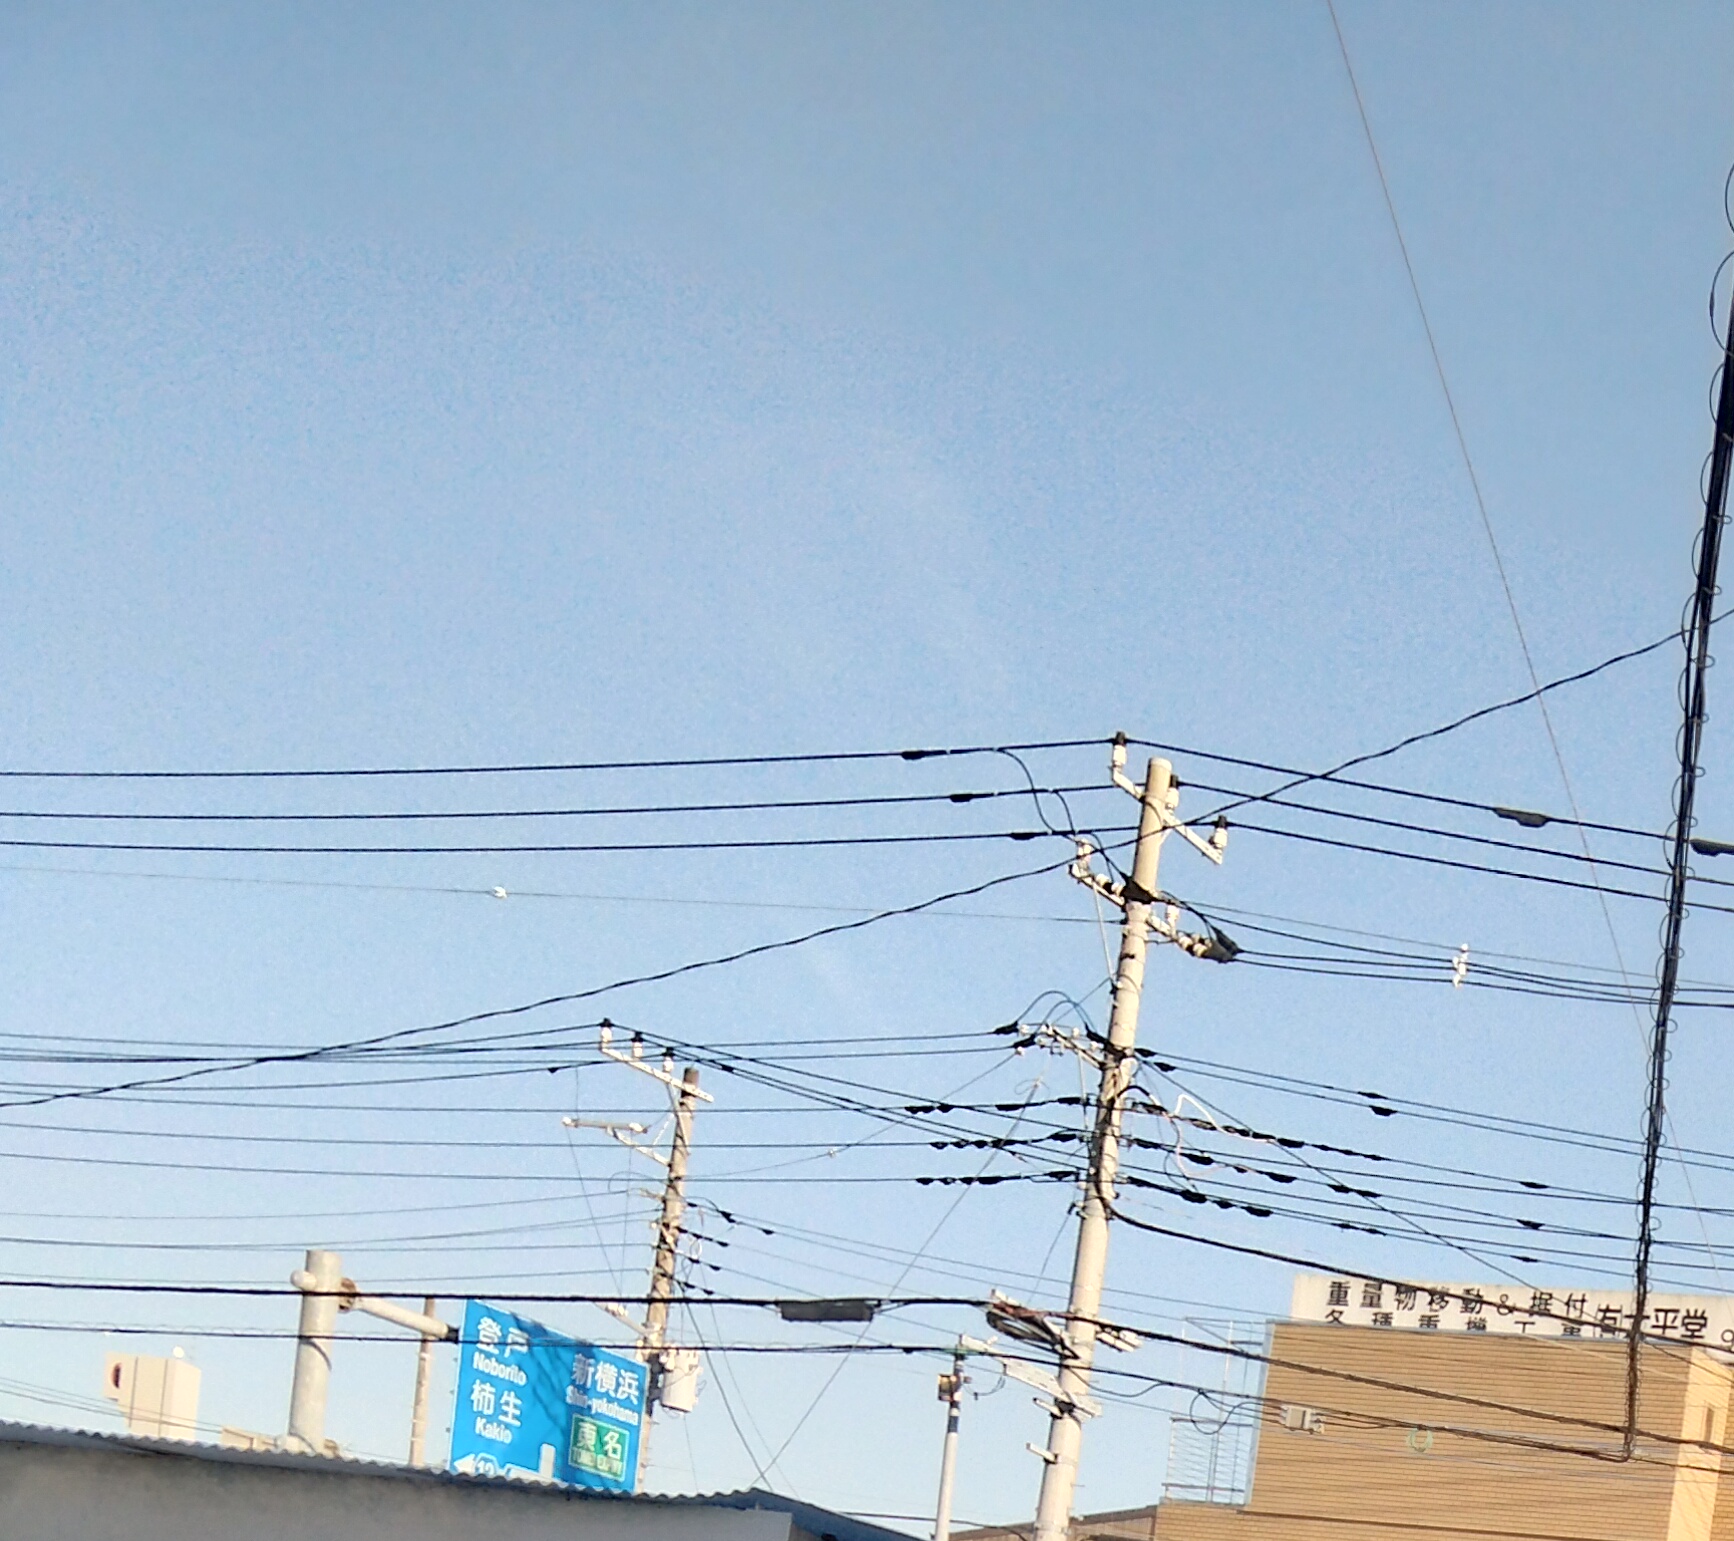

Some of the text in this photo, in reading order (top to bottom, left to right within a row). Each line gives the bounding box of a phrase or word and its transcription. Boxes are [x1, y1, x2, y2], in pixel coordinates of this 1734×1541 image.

[477, 1316, 530, 1359] 登戸
[473, 1351, 528, 1387] Noborito
[570, 1353, 640, 1406] 新横浜
[470, 1378, 523, 1428] 柿生
[474, 1415, 513, 1445] Kakio
[576, 1421, 622, 1461] 東名
